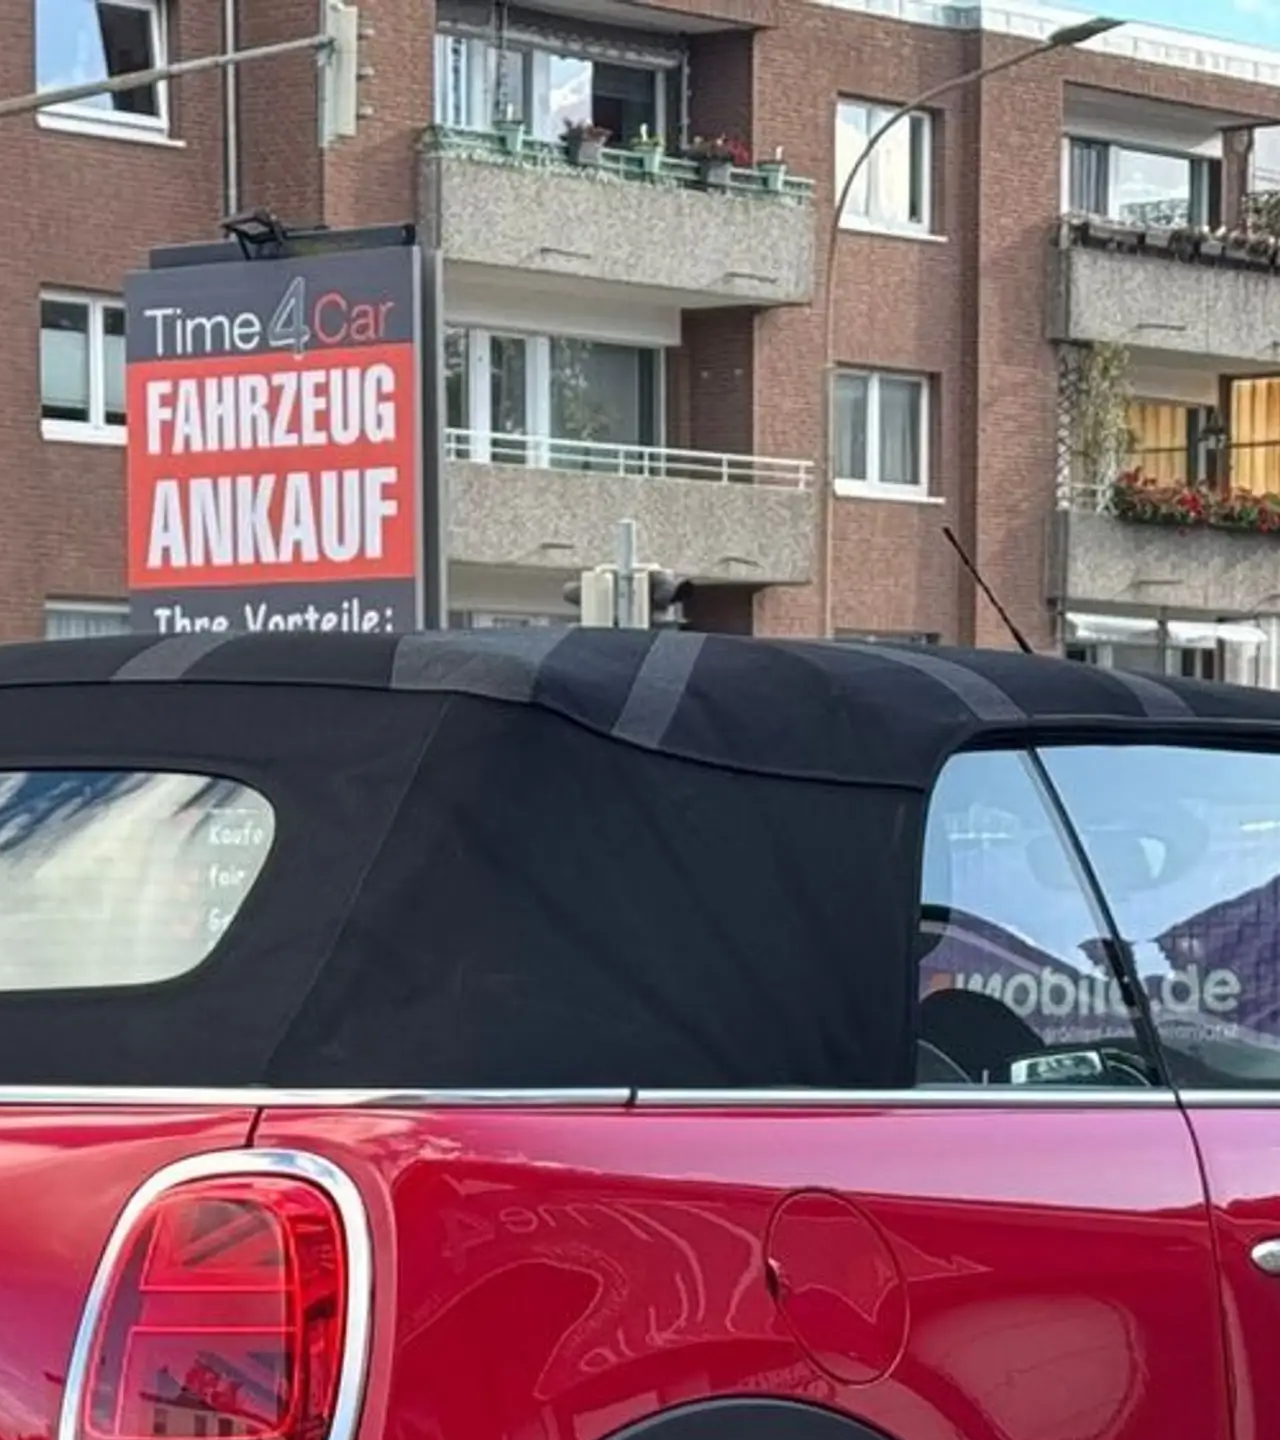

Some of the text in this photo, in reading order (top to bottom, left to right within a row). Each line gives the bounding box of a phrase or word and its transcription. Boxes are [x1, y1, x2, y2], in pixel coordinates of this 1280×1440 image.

[145, 362, 396, 456] FAHRZEUG
[146, 466, 399, 569] ANKAUF
[244, 597, 394, 633] Vorteile:
